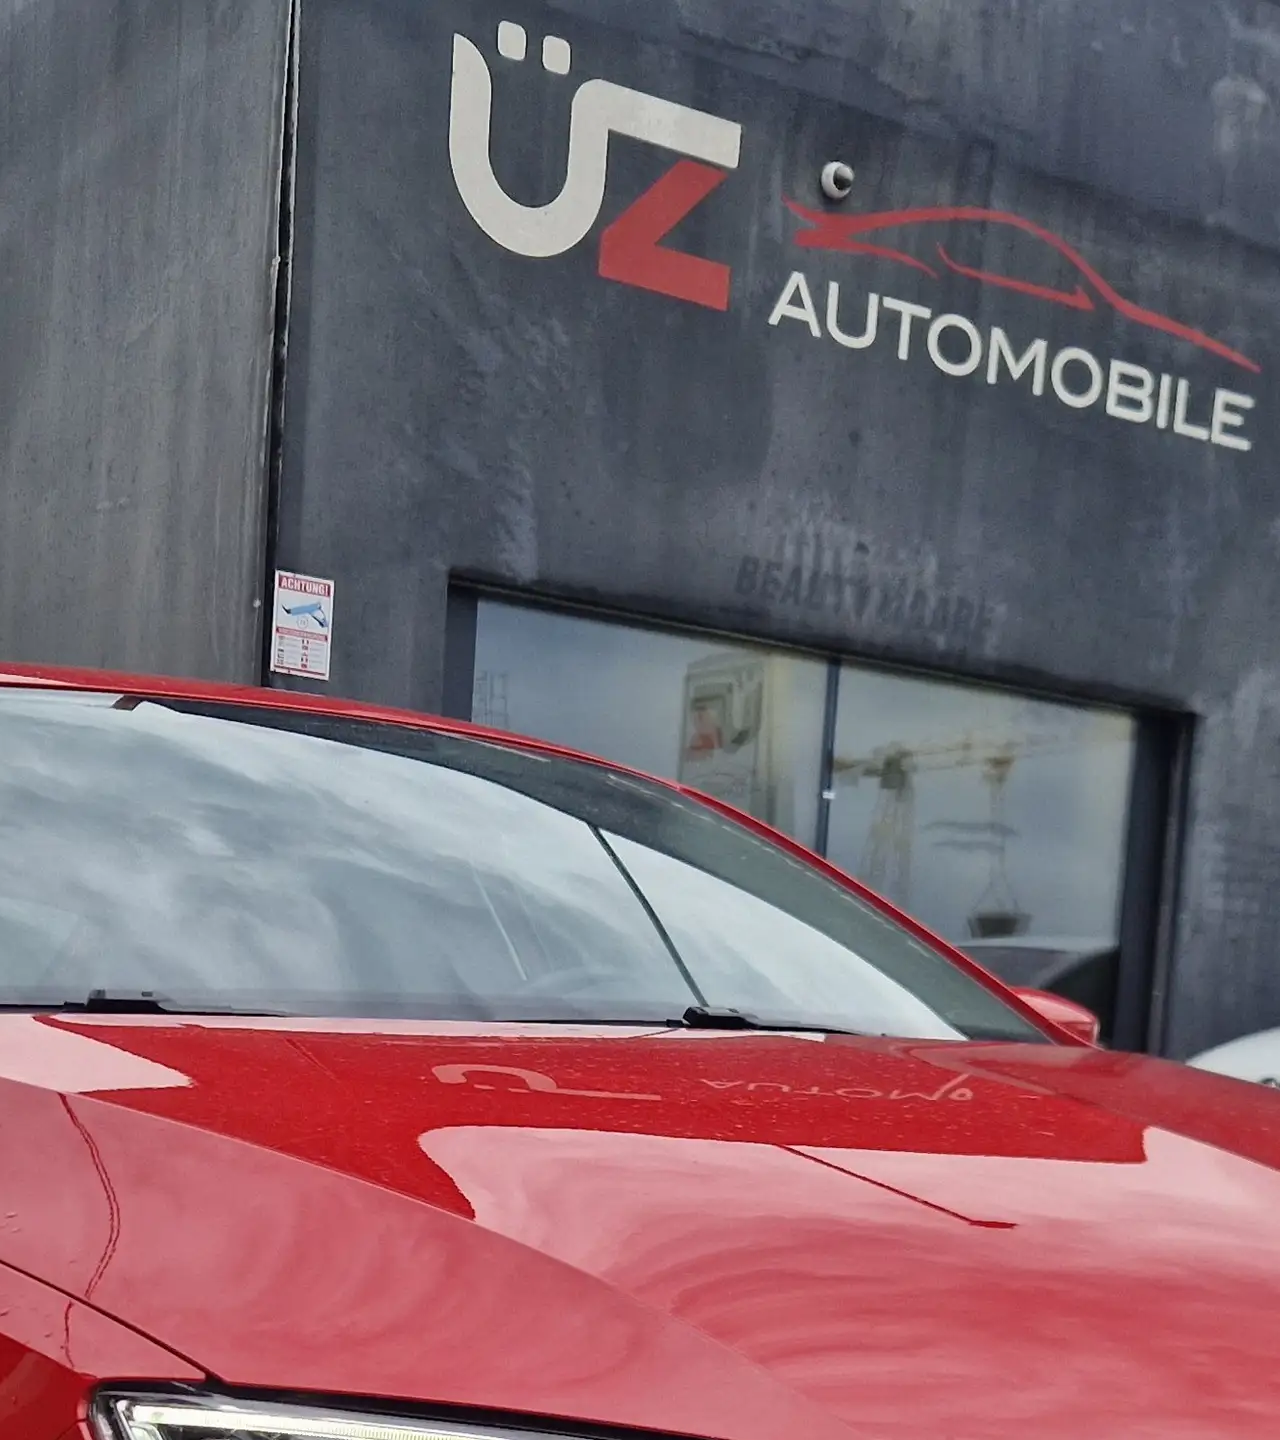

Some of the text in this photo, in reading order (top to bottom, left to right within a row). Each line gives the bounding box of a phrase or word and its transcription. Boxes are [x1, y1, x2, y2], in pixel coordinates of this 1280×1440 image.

[449, 19, 742, 311] ÜZ
[768, 271, 1255, 452] AUTOMOBILE
[280, 576, 329, 597] ACHTUNG!
